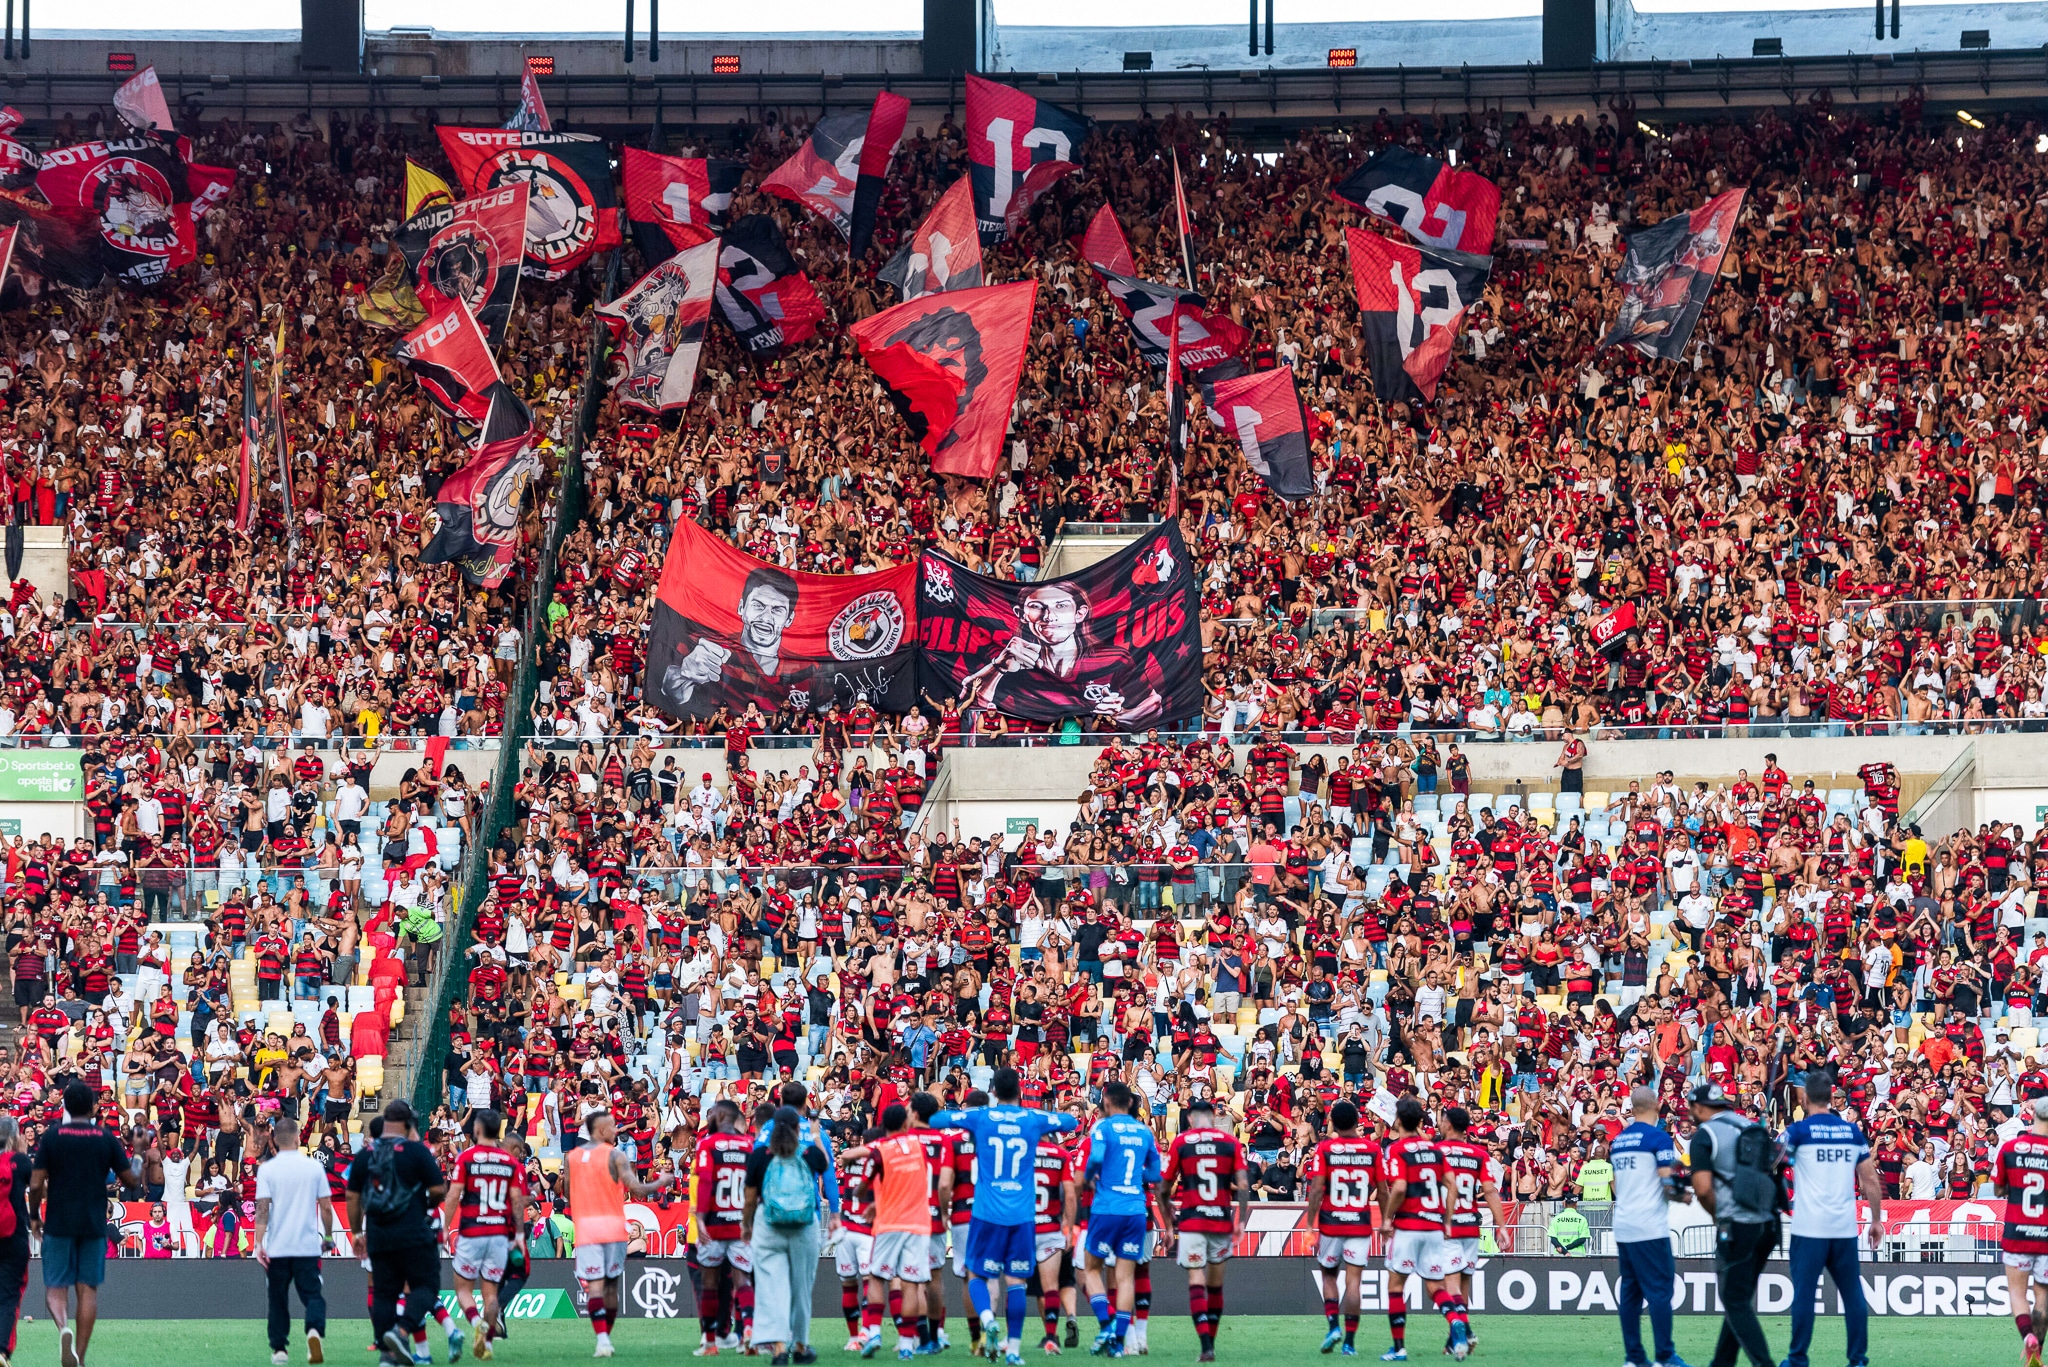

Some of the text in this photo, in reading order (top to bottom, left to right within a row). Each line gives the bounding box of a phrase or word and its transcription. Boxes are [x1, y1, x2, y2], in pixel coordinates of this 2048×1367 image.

[496, 151, 549, 173] FLA
[1179, 345, 1228, 366] NORTE
[1113, 589, 1186, 650] LUIS
[884, 627, 900, 652] MANTO
[1627, 708, 1641, 724] 10
[11, 760, 75, 772] Sportsbet.io
[17, 776, 52, 787] aposte
[1869, 771, 1885, 785] 16
[988, 1137, 1028, 1179] 17
[1123, 1149, 1136, 1186] 1
[1816, 1149, 1852, 1162] BEPE
[474, 1178, 508, 1215] 14
[716, 1167, 747, 1209] 20
[1196, 1158, 1218, 1201] 5
[1331, 1169, 1370, 1208] 63
[1419, 1168, 1441, 1209] 3
[2022, 1172, 2045, 1217] 2
[1497, 1270, 1537, 1311] O
[1838, 1274, 2036, 1317] INGRES
